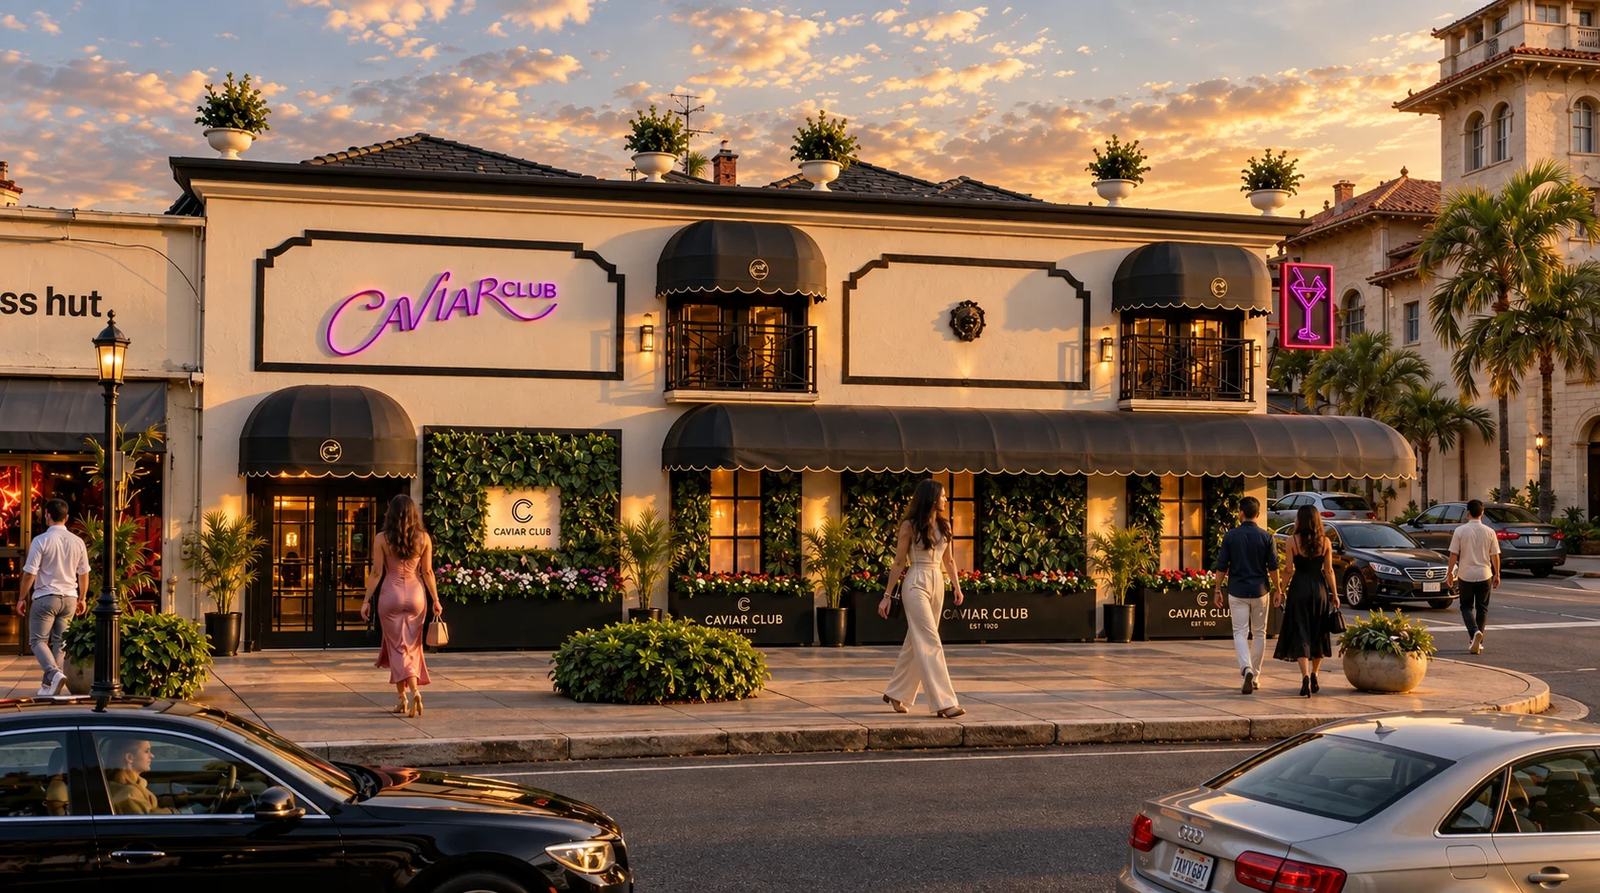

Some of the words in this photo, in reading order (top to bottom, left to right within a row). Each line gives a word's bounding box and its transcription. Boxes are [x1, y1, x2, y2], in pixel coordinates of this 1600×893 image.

[502, 281, 557, 299] CLUB
[46, 286, 102, 317] hut
[493, 527, 527, 536] CAVIAR
[528, 527, 552, 536] CLUB
[705, 614, 748, 625] CAVIAR
[751, 614, 783, 625] CLUB
[942, 608, 989, 620] CAVIAR
[992, 607, 1029, 620] CLUB
[1168, 608, 1207, 619] CAVIAR
[1209, 608, 1232, 618] CLU
